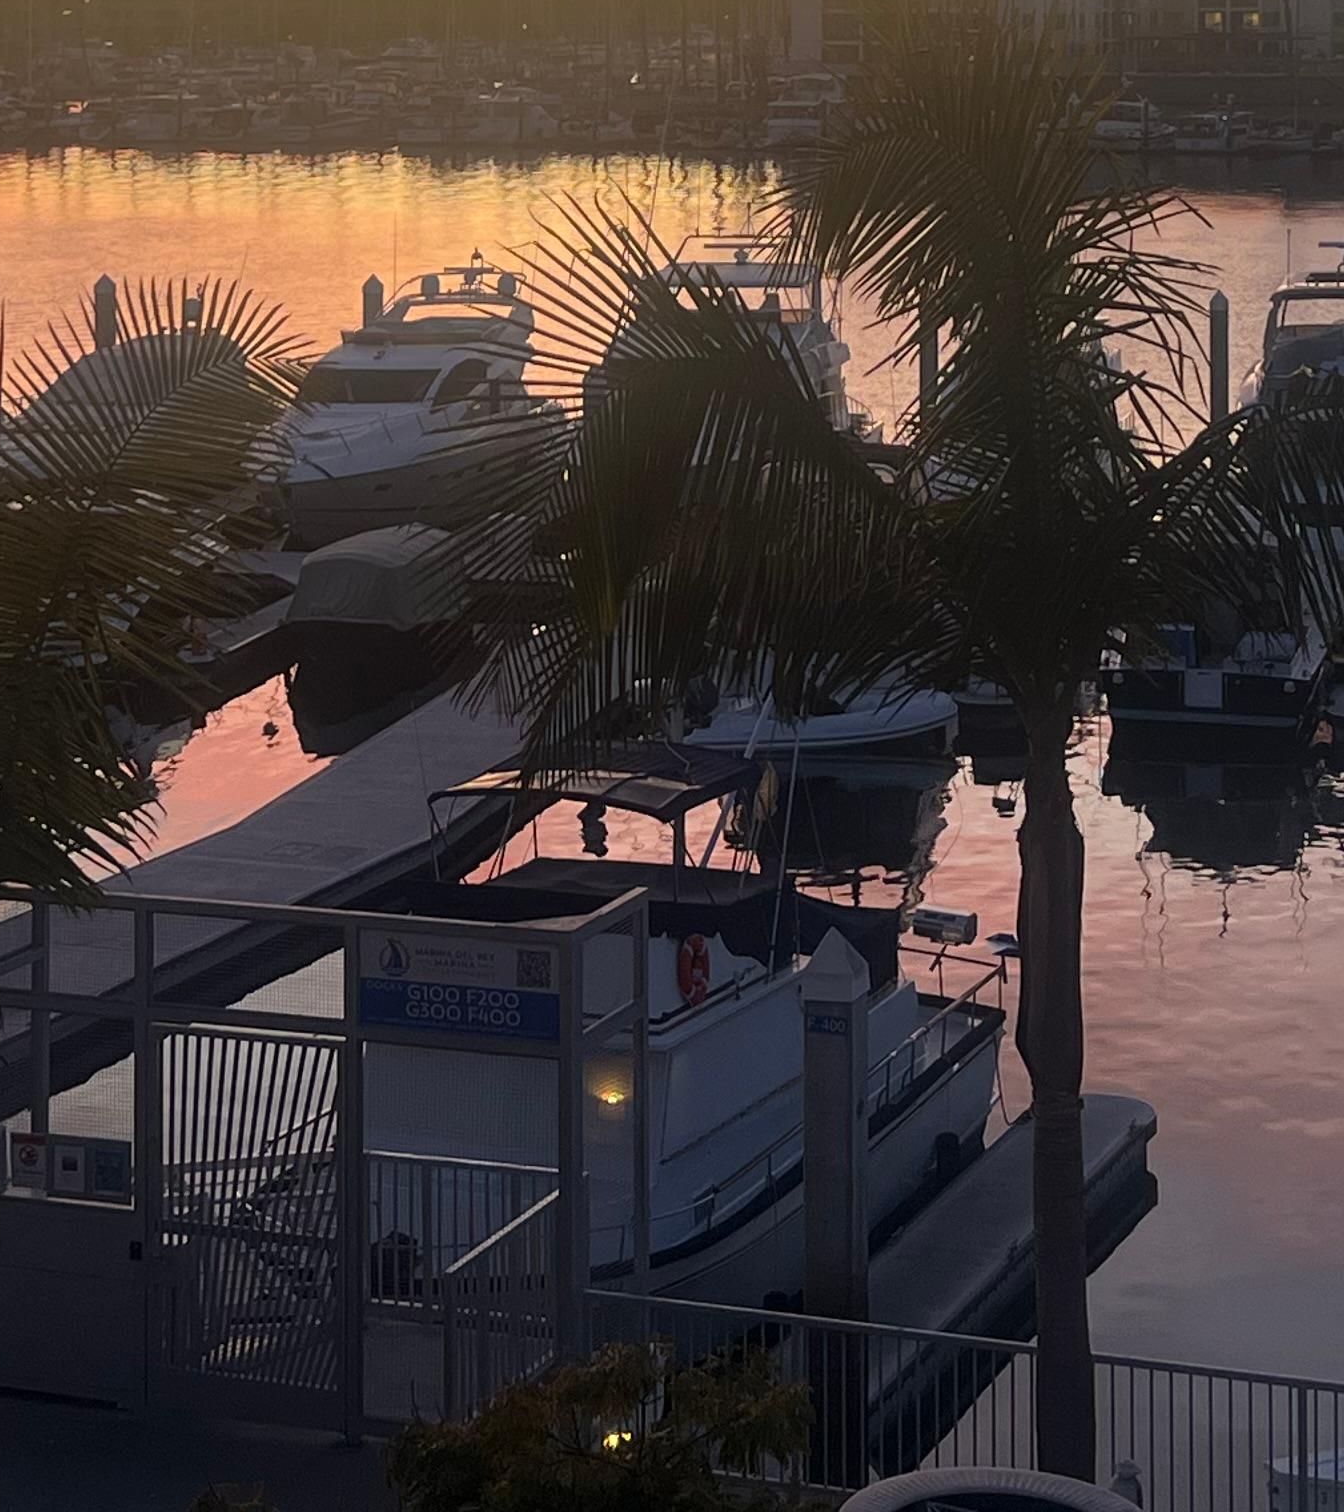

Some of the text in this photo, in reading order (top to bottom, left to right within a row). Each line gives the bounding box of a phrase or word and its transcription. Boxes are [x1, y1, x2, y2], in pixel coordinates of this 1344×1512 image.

[435, 958, 476, 968] MARINA
[407, 984, 460, 1004] G100
[466, 989, 520, 1009] F200
[405, 1001, 462, 1021] G300
[467, 1007, 522, 1026] F400
